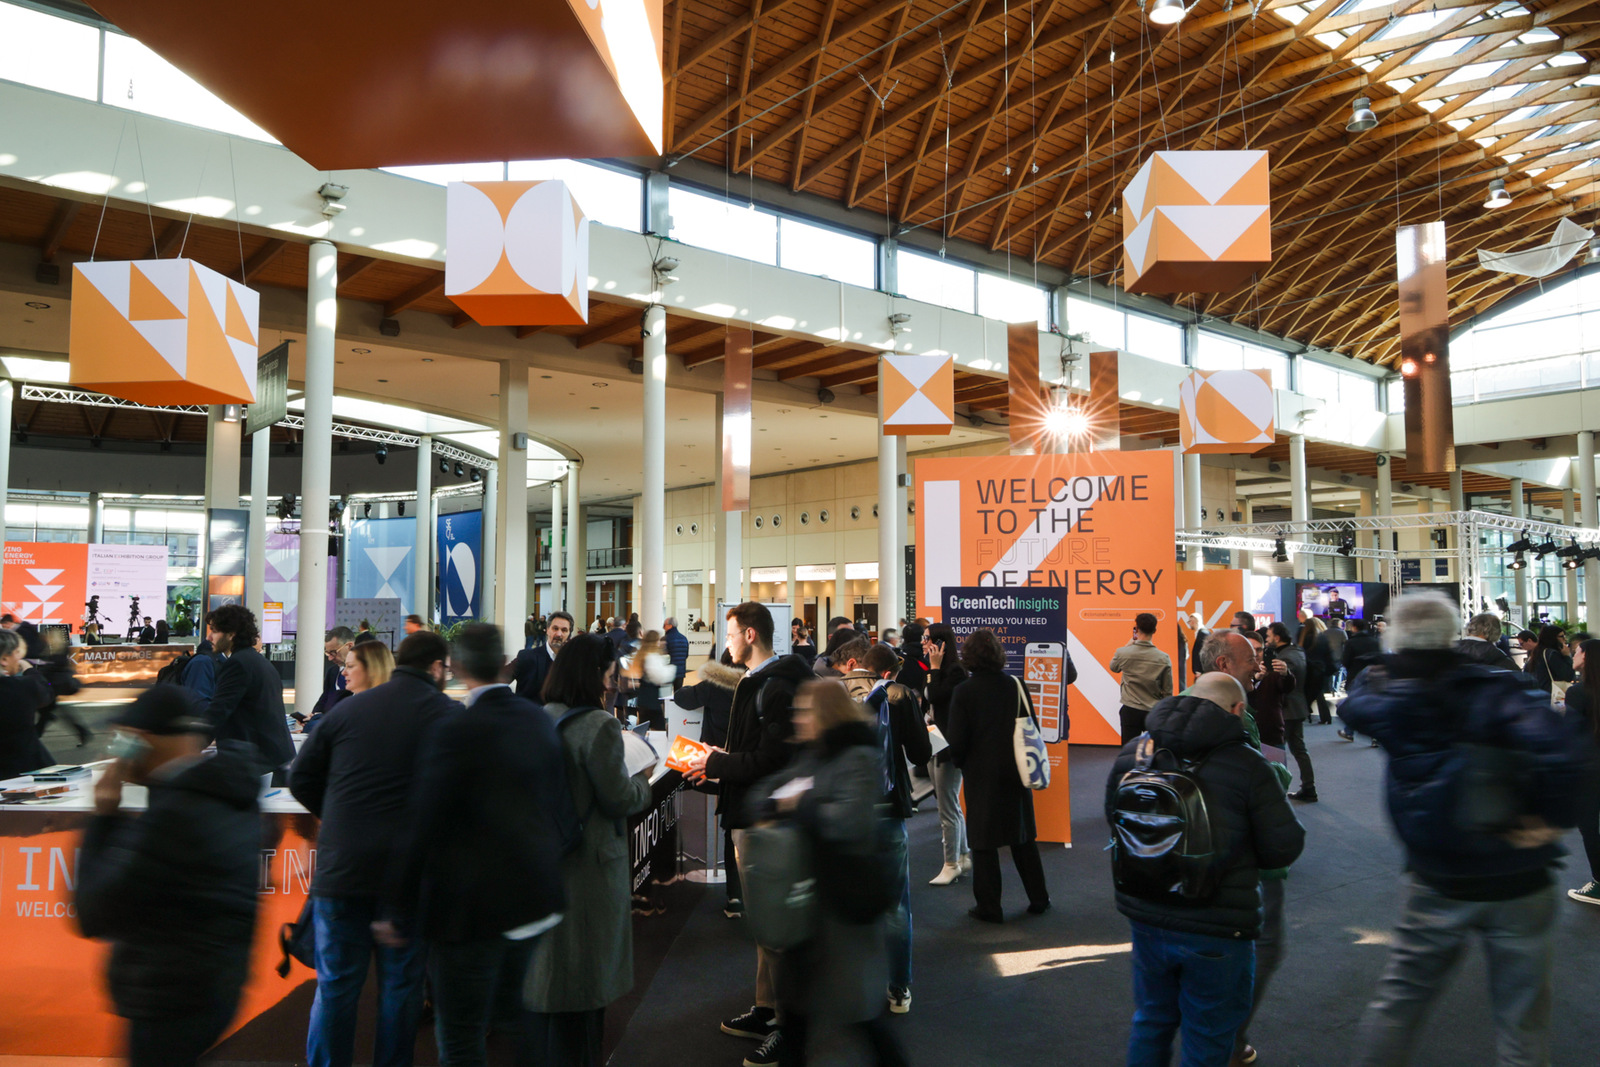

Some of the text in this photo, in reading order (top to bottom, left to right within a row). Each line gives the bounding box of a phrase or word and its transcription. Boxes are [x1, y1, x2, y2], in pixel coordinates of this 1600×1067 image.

[976, 475, 1149, 504] WELCOME
[976, 507, 1095, 535] TO THE
[976, 537, 1111, 566] FUTURE
[977, 568, 1164, 596] OF ENERGY
[1536, 578, 1551, 601] D
[949, 594, 1060, 612] GreenTechInsights
[950, 617, 1048, 625] EVERYTHING YOU NEED
[951, 626, 978, 634] ABOUT
[997, 626, 1009, 634] AT
[997, 635, 1028, 644] ERTIPS
[84, 650, 152, 660] MAIN STAGE
[633, 808, 659, 869] INFO
[15, 901, 78, 918] WELCO
